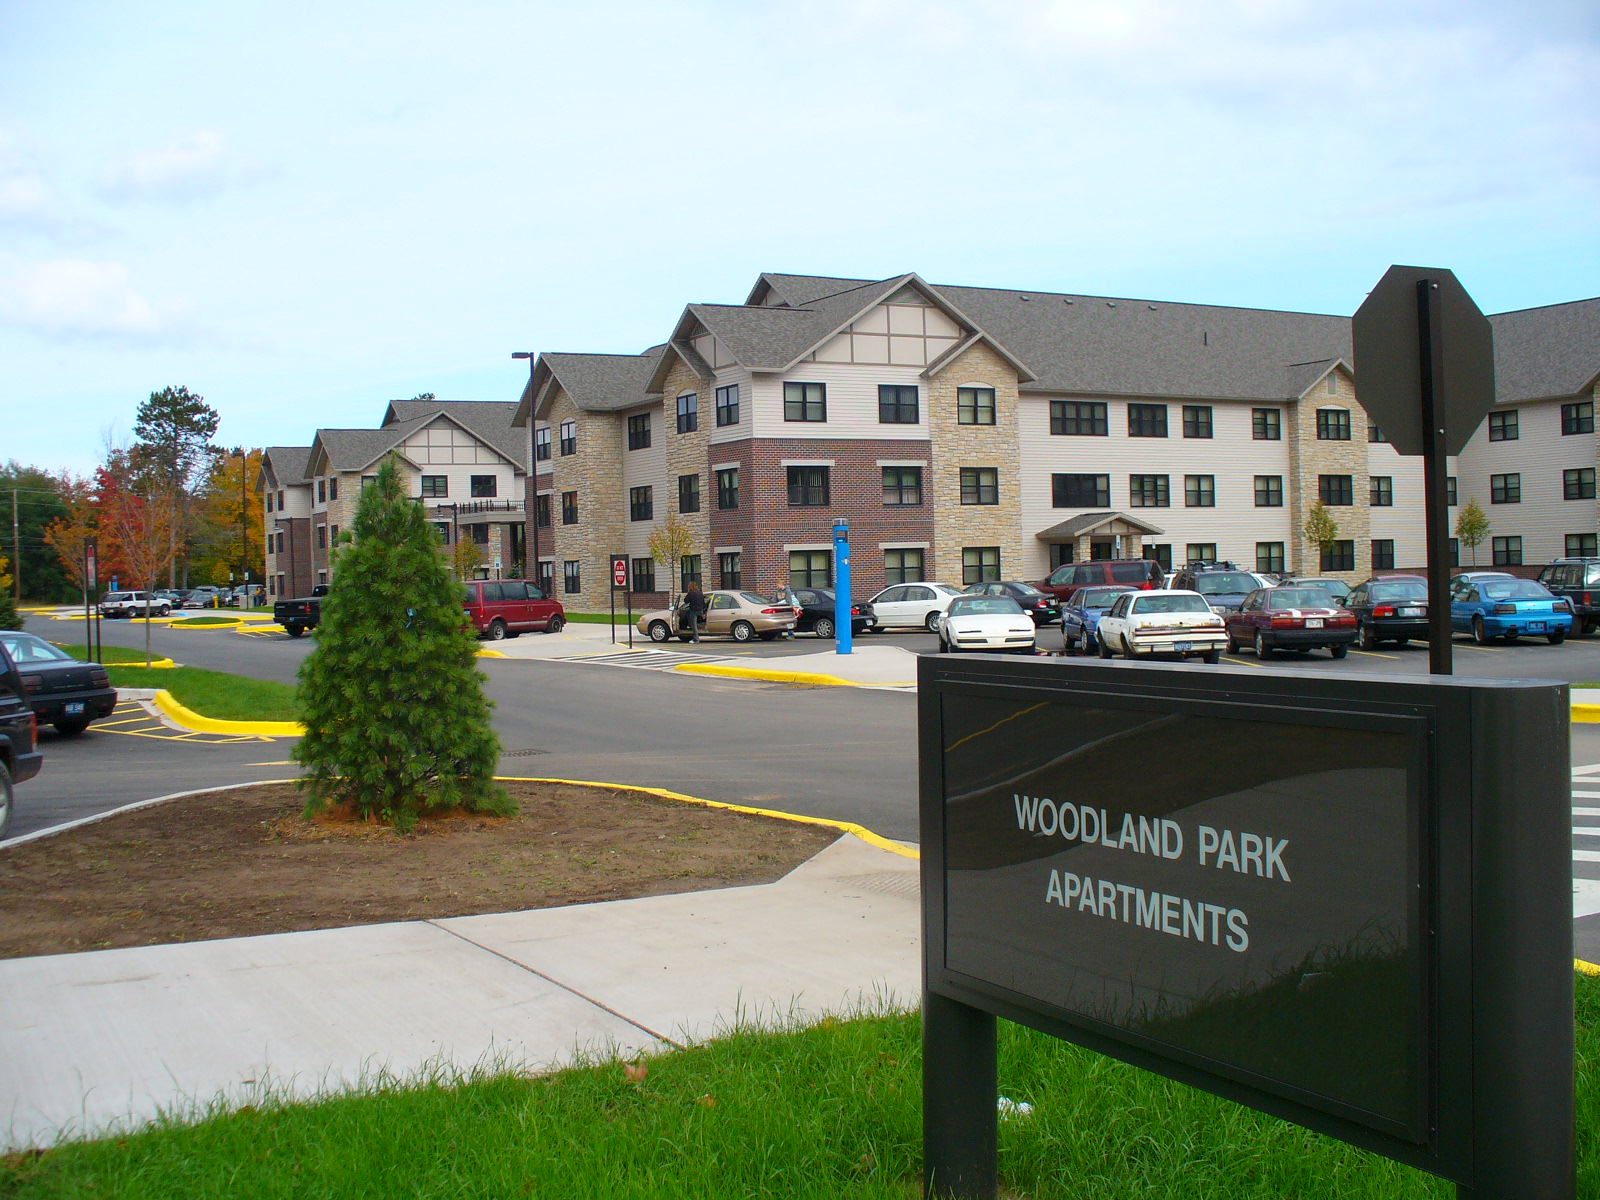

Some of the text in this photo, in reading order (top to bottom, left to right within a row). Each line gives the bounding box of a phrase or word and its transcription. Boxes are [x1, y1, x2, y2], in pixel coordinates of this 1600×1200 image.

[1014, 794, 1292, 882] WOODLAND PARK
[1045, 869, 1249, 953] APARTMENTS
